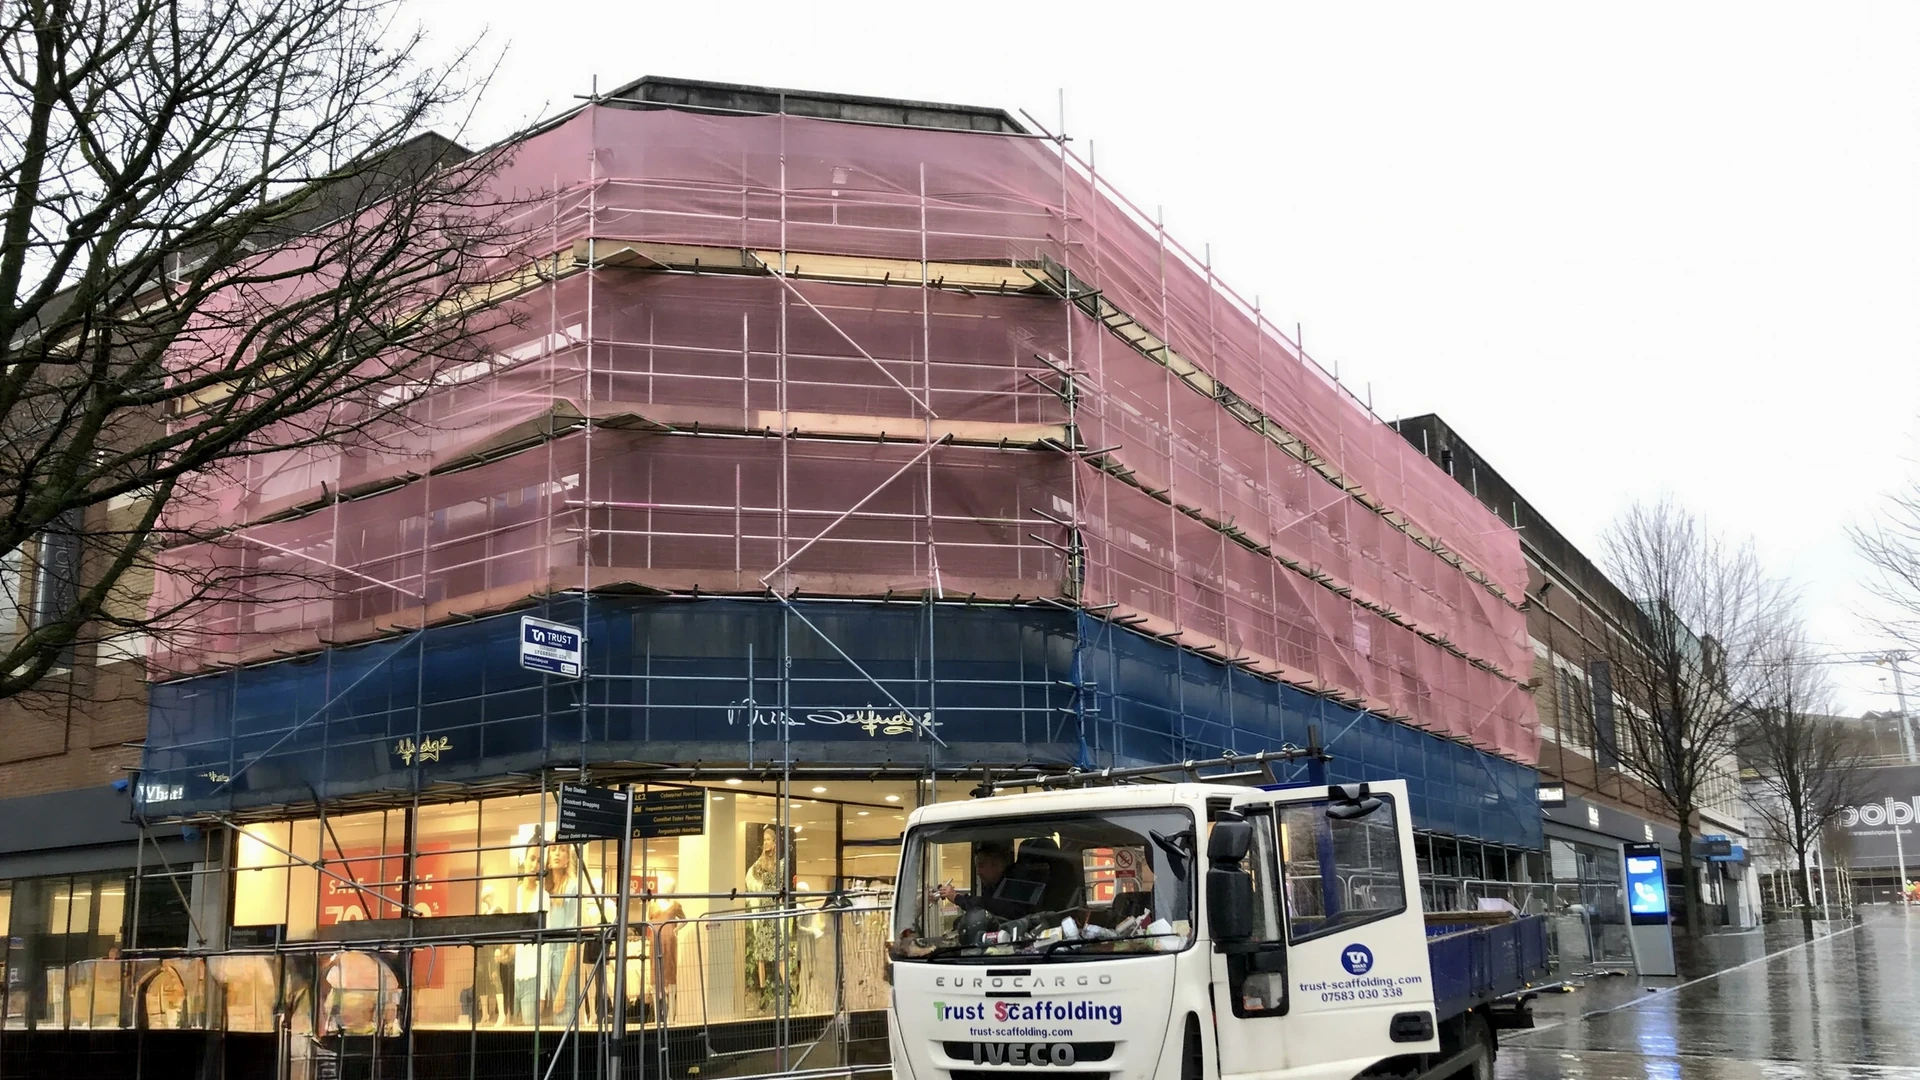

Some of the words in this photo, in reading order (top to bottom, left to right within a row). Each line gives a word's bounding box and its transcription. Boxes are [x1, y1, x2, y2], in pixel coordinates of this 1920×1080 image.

[547, 631, 572, 645] TRUST
[935, 974, 1112, 988] EUROCARGO
[1299, 974, 1422, 991] trust-scaffolding.com
[1321, 989, 1355, 1002] 07583
[1358, 988, 1379, 1000] 030
[1382, 987, 1403, 998] 338
[933, 1001, 985, 1022] Trust
[994, 1001, 1122, 1025] Scaffolding
[970, 1027, 1073, 1038] trust-scaffolding.com
[973, 1042, 1075, 1066] IVECO
